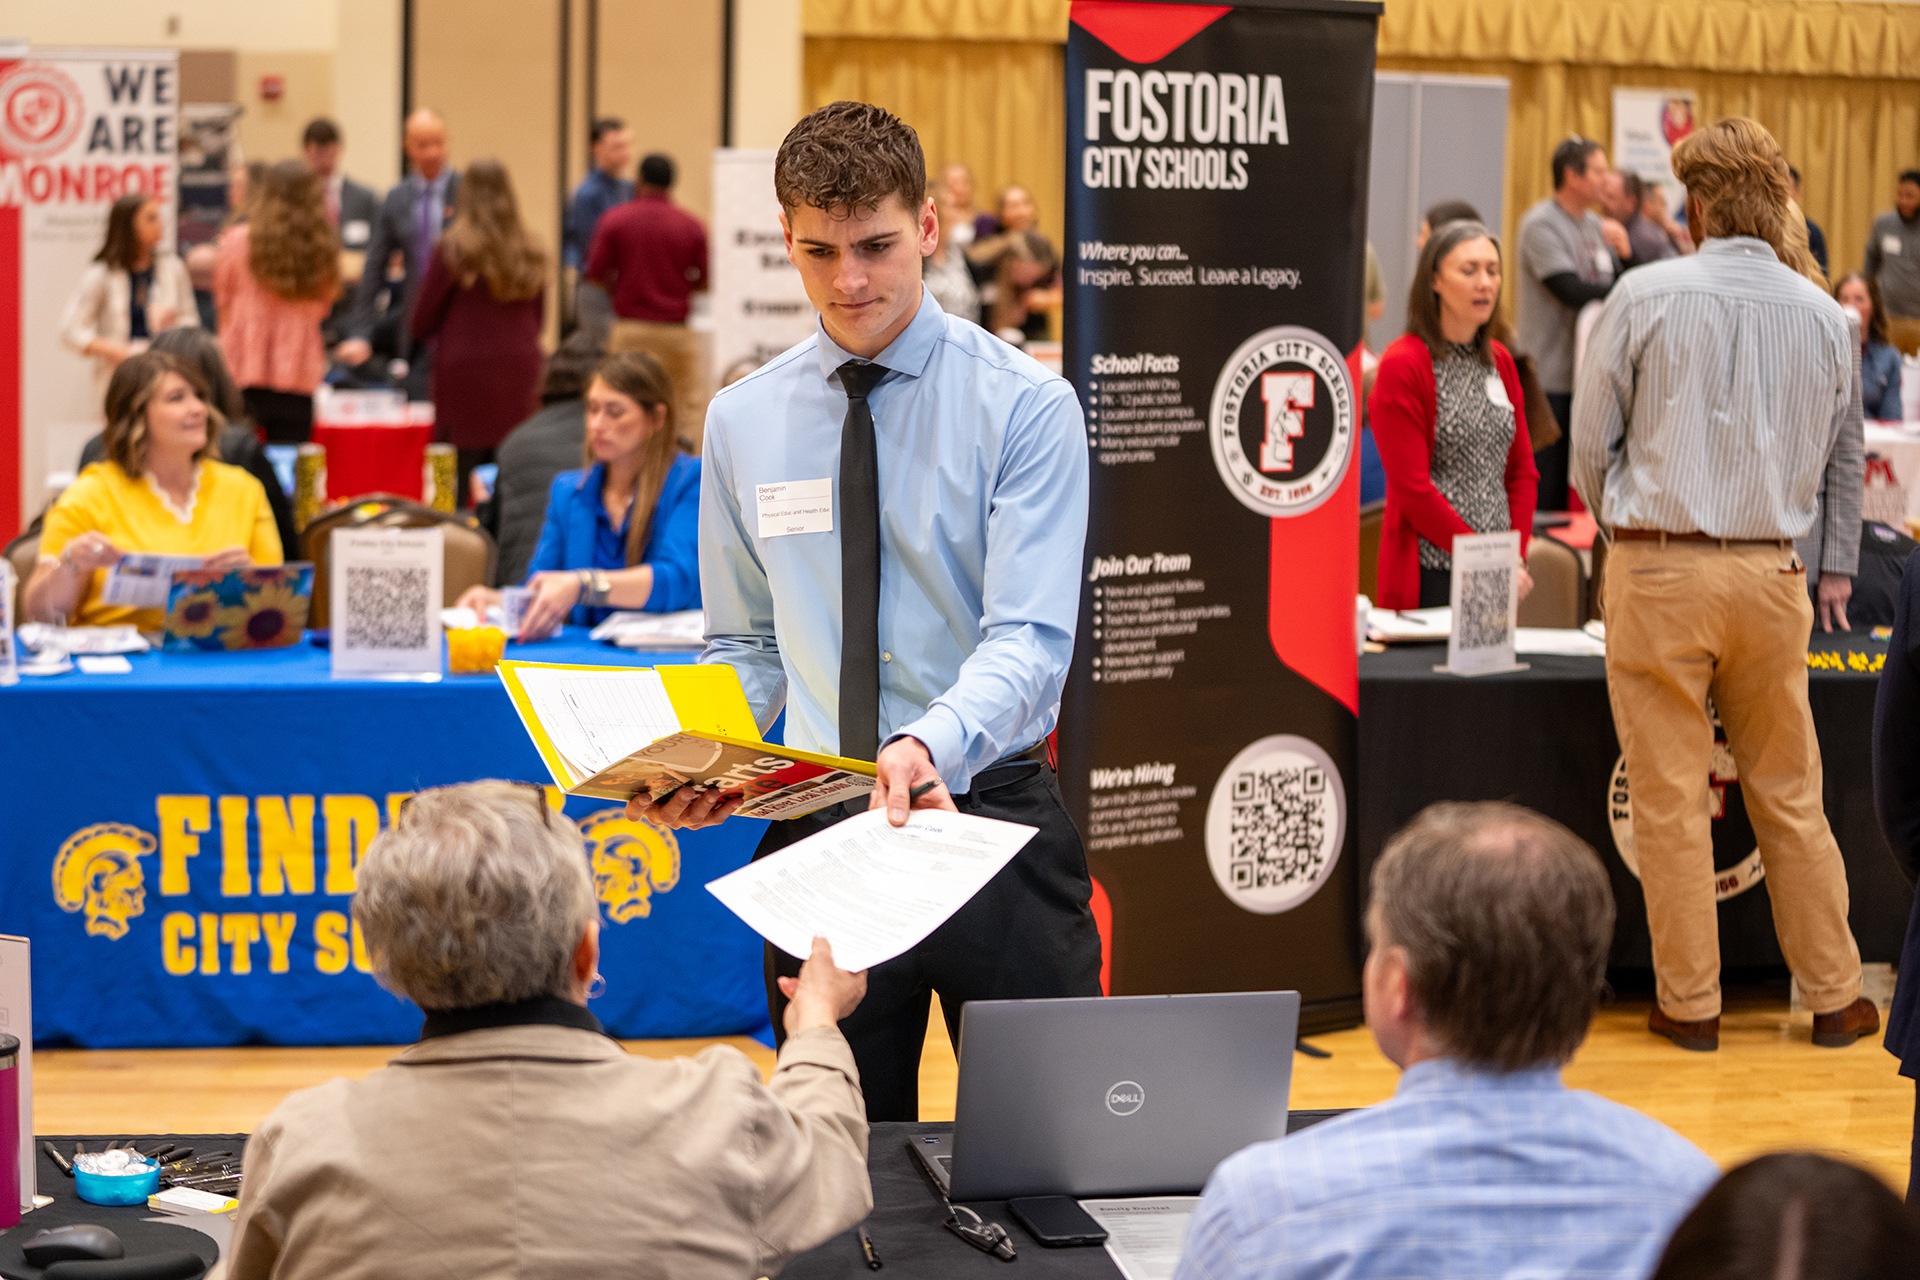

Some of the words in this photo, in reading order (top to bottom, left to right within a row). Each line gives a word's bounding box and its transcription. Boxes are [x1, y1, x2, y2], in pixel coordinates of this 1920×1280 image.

[104, 67, 172, 105] WE
[1085, 69, 1289, 145] FOSTORIA
[87, 115, 172, 154] ARE
[1083, 146, 1142, 189] CITY
[1143, 147, 1249, 190] SCHOOLS
[1078, 241, 1129, 261] Where
[1127, 245, 1157, 266] you
[1156, 245, 1189, 261] can...
[1078, 266, 1134, 290] Inspire.
[1138, 265, 1196, 286] Succeed.
[1200, 265, 1239, 286] Leave
[1240, 270, 1250, 286] a
[1252, 265, 1302, 290] Legacy.
[1090, 353, 1143, 375] School
[1143, 353, 1180, 373] Facts
[1102, 380, 1136, 392] Located
[1224, 351, 1269, 439] FOSTORIA
[1276, 343, 1316, 360] CITY
[1318, 356, 1348, 434] SCHOOLS
[1102, 408, 1136, 420] Located
[759, 486, 786, 494] Benjamin
[759, 494, 775, 502] Cook
[1088, 554, 1124, 582] Join
[1125, 554, 1153, 576] Our
[1153, 552, 1191, 574] Team
[1090, 767, 1133, 789] We're
[1133, 762, 1176, 786] Hiring
[161, 911, 297, 976] CITY
[1110, 1093, 1141, 1103] DELL
